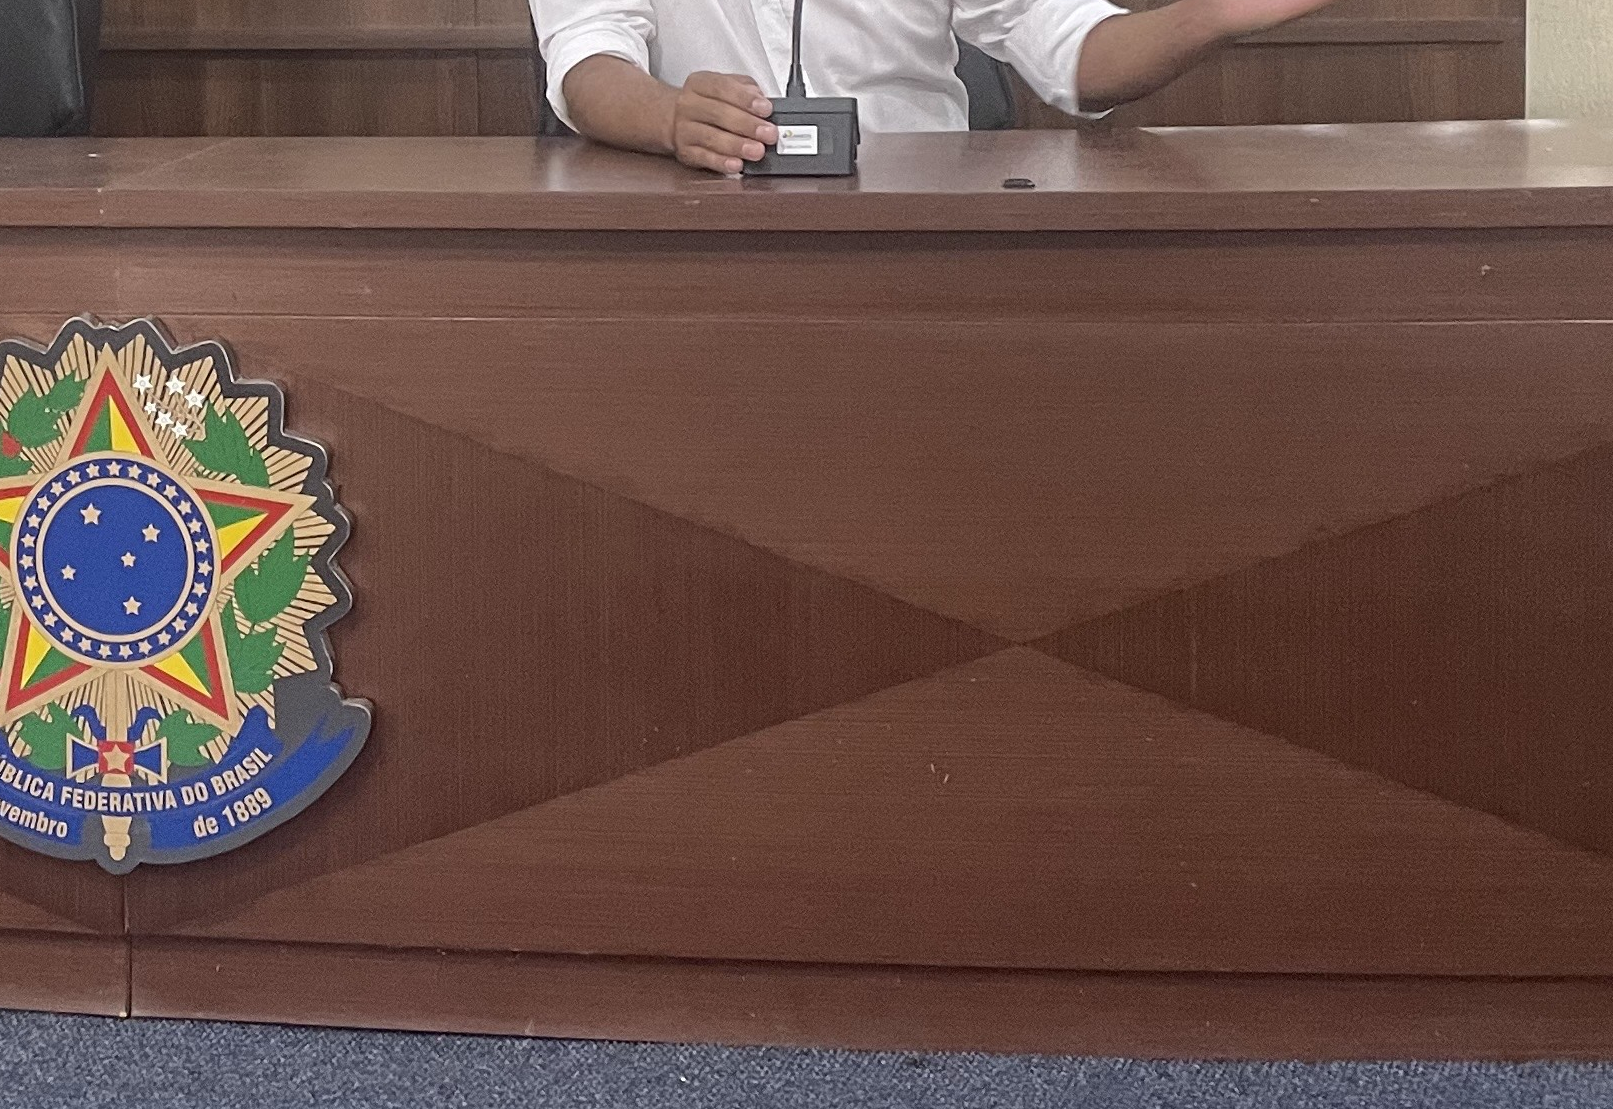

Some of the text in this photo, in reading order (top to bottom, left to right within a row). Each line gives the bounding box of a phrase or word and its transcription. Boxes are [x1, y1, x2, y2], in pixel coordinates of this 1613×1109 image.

[60, 786, 178, 813] FEDERATIVA
[181, 781, 209, 805] DO
[210, 747, 273, 795] BRASIL
[193, 814, 219, 838] de
[222, 787, 273, 827] 1889
